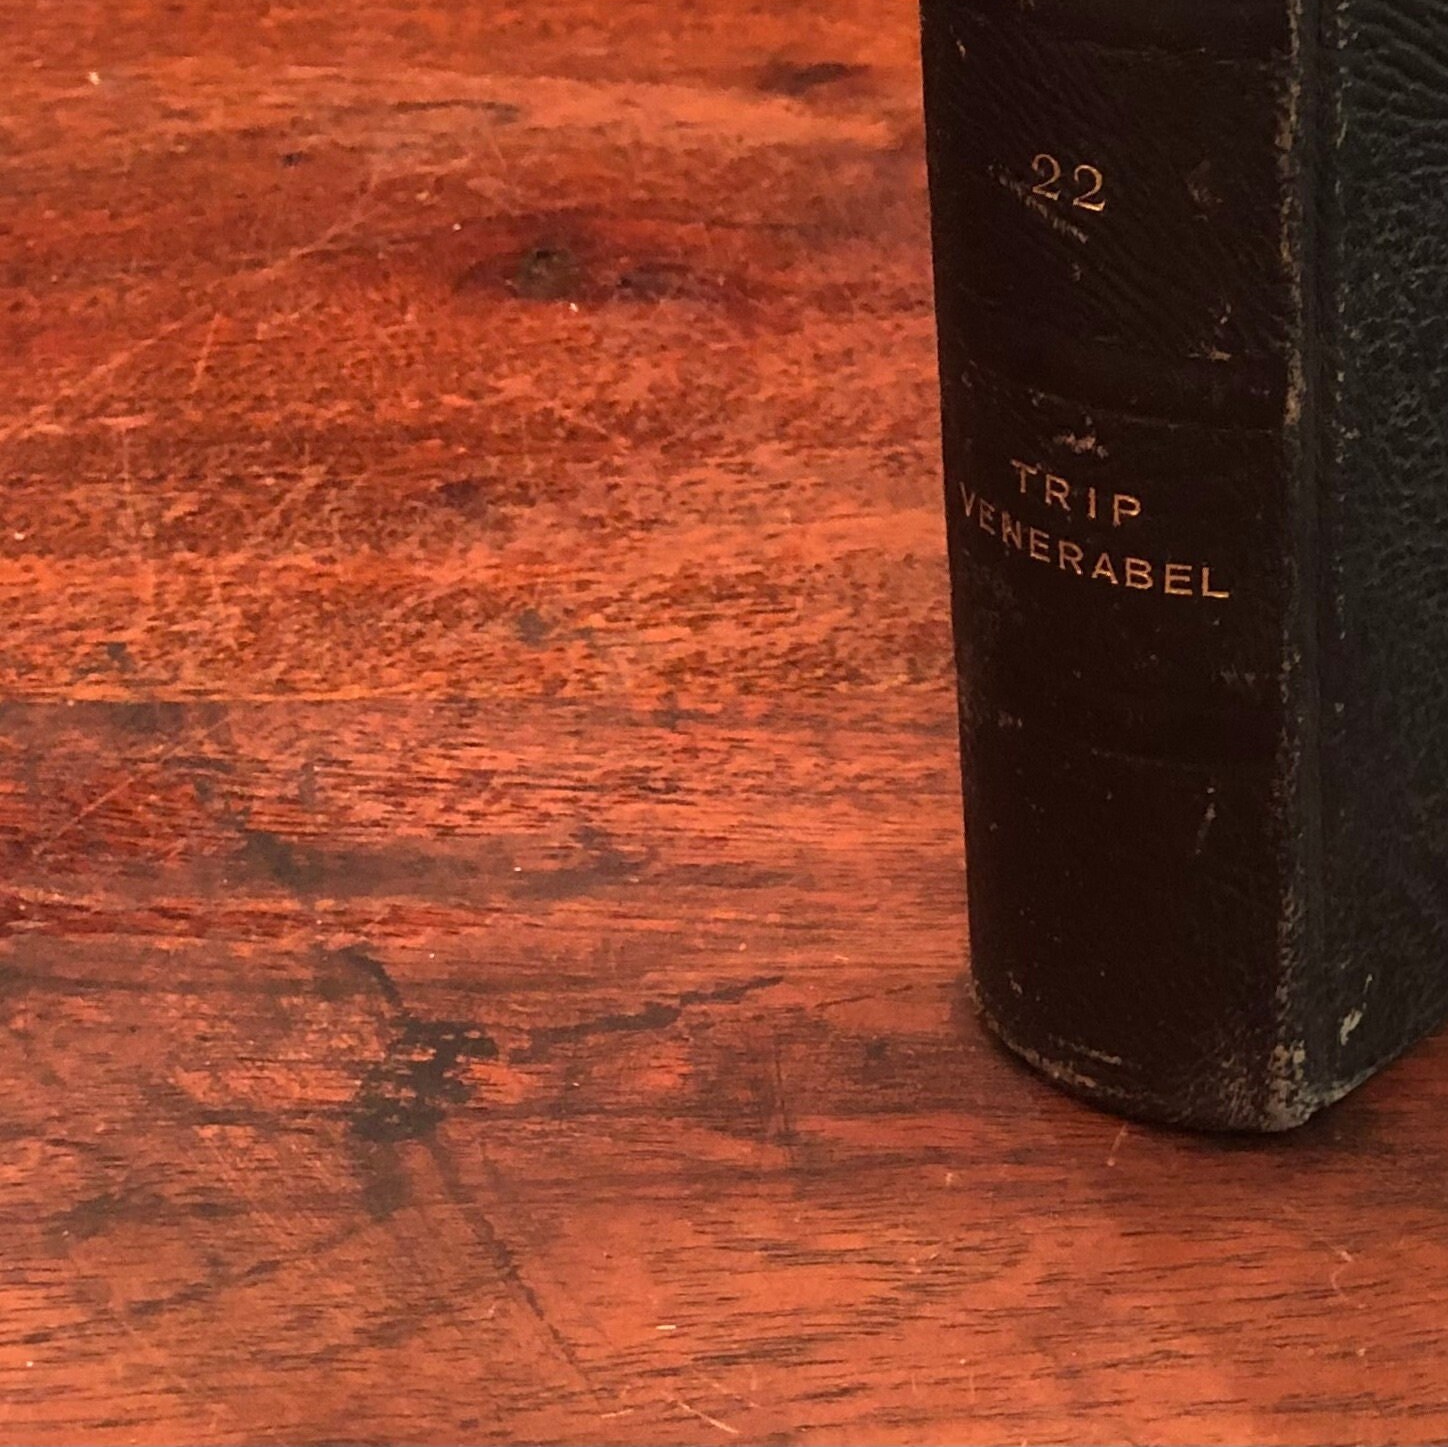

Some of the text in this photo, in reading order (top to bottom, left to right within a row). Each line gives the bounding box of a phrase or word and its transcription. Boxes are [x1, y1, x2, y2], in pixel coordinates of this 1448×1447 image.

[1030, 153, 1107, 212] 22
[1010, 459, 1142, 527] TRIP
[958, 481, 1230, 599] VENERABEL
